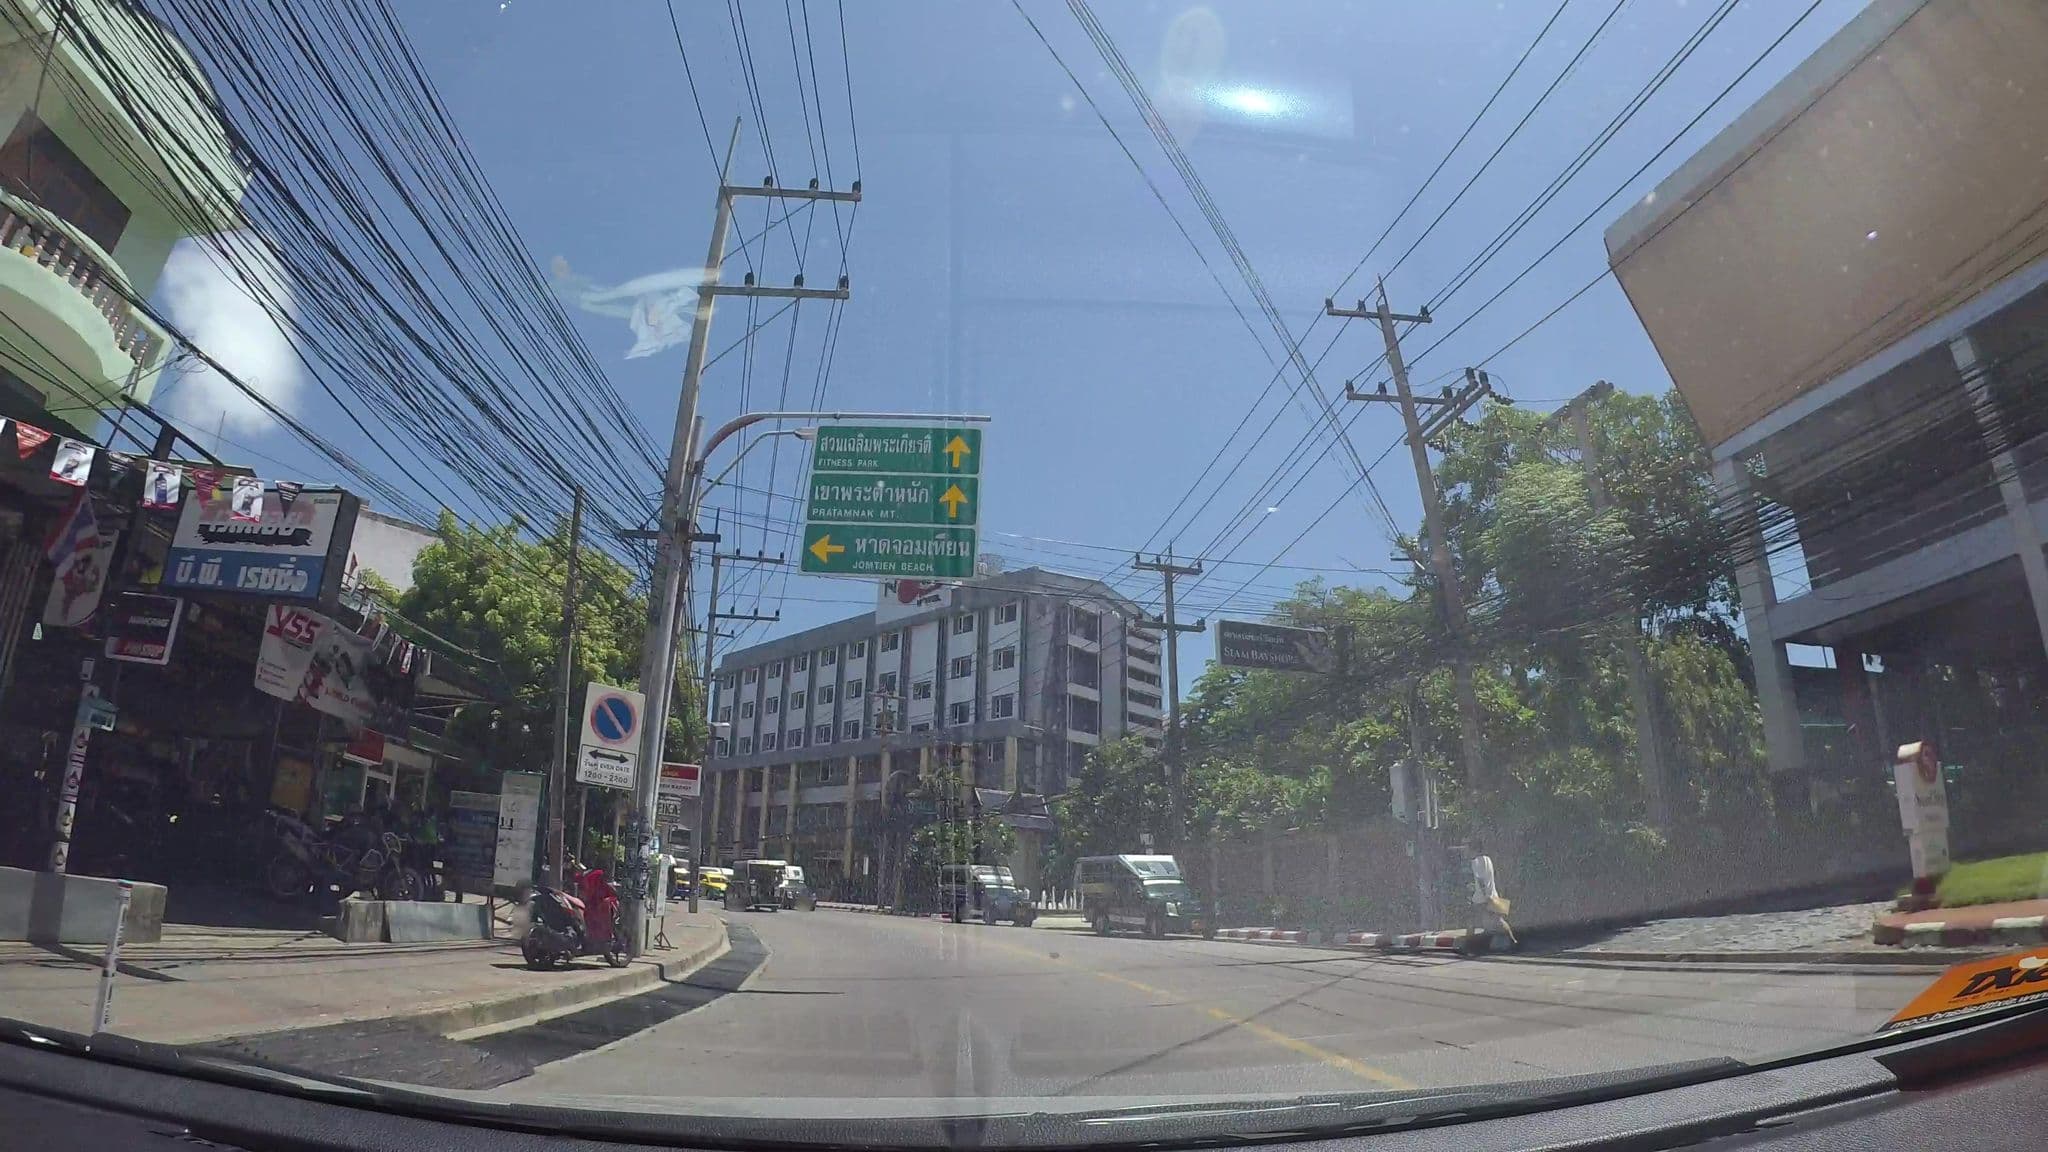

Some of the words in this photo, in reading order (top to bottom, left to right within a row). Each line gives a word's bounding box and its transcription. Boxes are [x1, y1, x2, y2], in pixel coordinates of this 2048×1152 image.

[818, 458, 853, 468] FITNESS
[857, 459, 879, 468] PARK
[814, 480, 929, 504] เขาพระตำหนัก
[812, 507, 874, 518] PRATAMNAK
[855, 532, 970, 557] หาดจอมเทียน
[852, 560, 896, 571] JOMTIEN
[901, 561, 934, 572] BEACH
[266, 601, 321, 645] YSS
